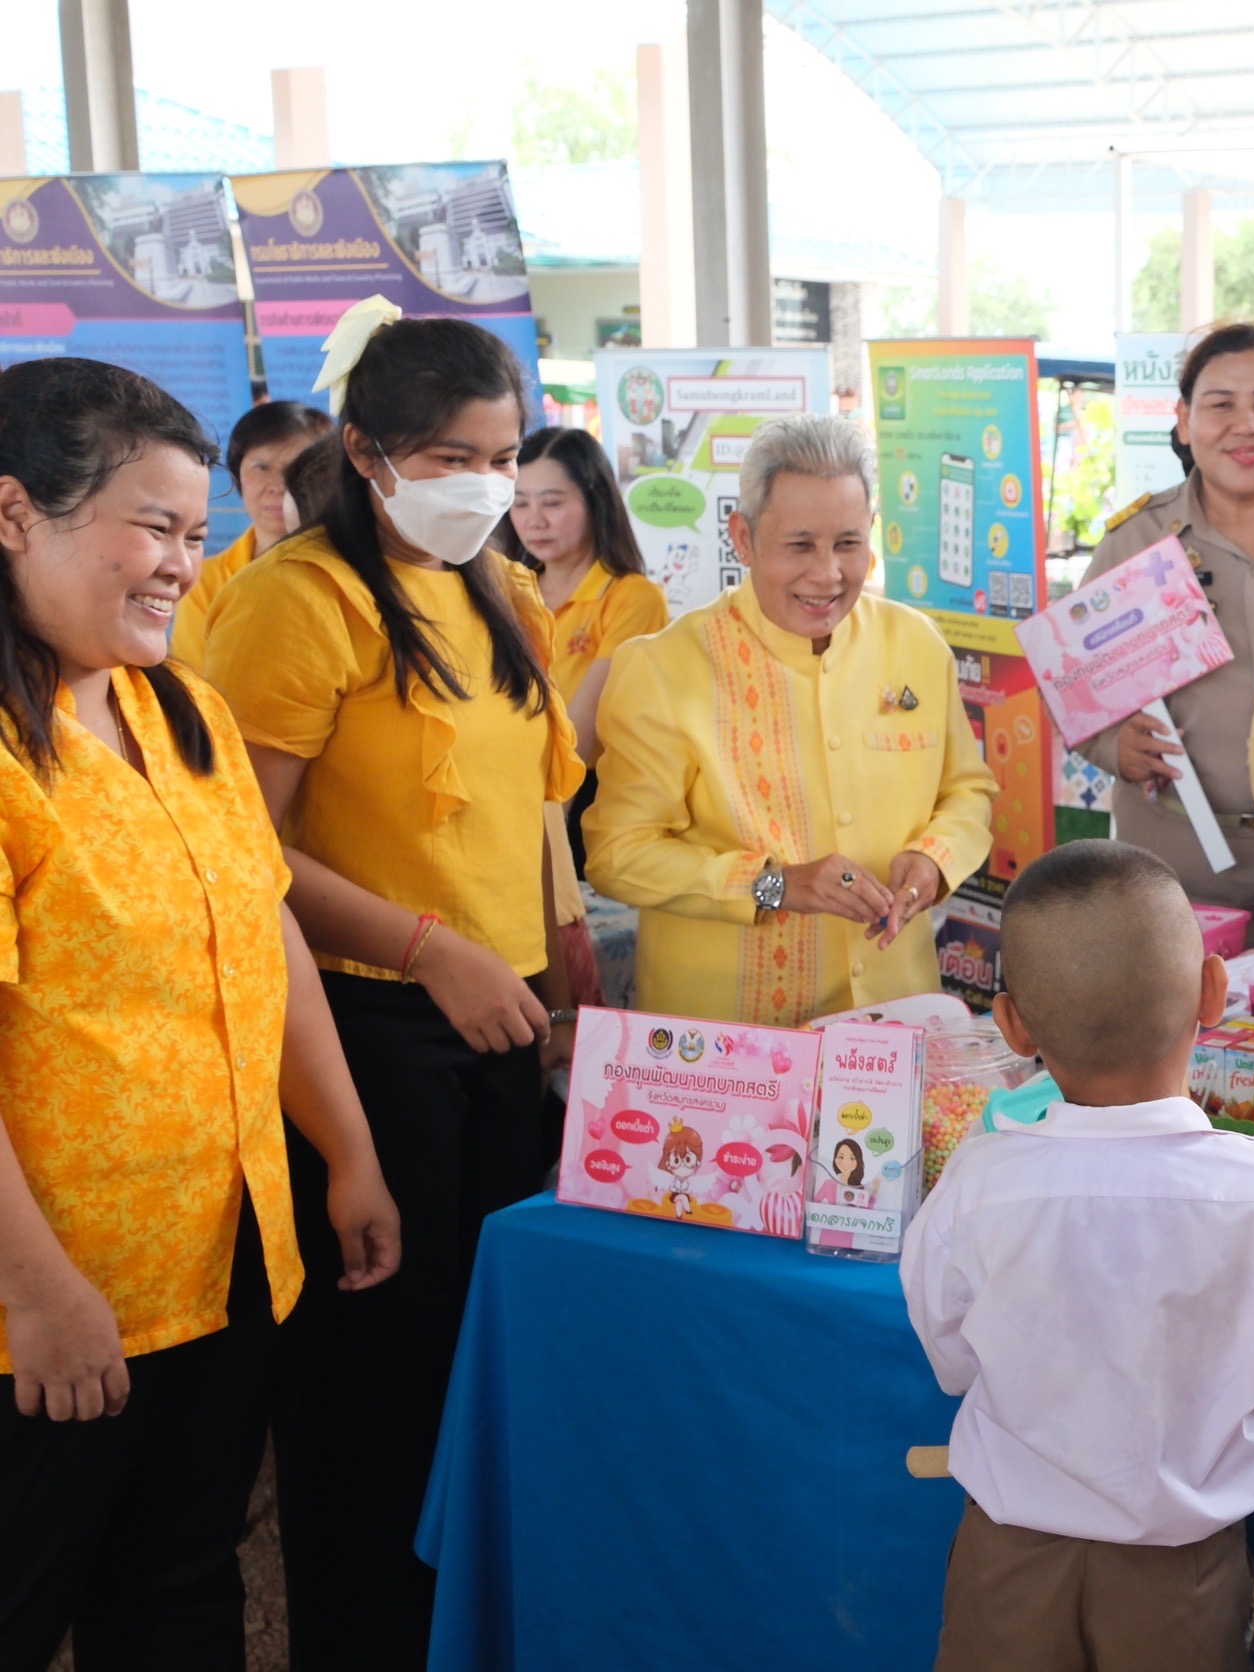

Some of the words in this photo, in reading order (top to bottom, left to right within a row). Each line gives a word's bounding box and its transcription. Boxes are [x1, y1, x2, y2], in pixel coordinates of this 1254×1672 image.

[835, 1047, 898, 1073] พลังสตรี
[604, 1062, 778, 1098] กองทุนพัฒนาบทบาทสตรี
[615, 1118, 654, 1134] ดอกเบี้ยต่ำ
[589, 1158, 621, 1175] วงเงินสูง
[723, 1151, 757, 1166] ชำระง่าย
[808, 1211, 896, 1232] เอกสารแจกฟรี
